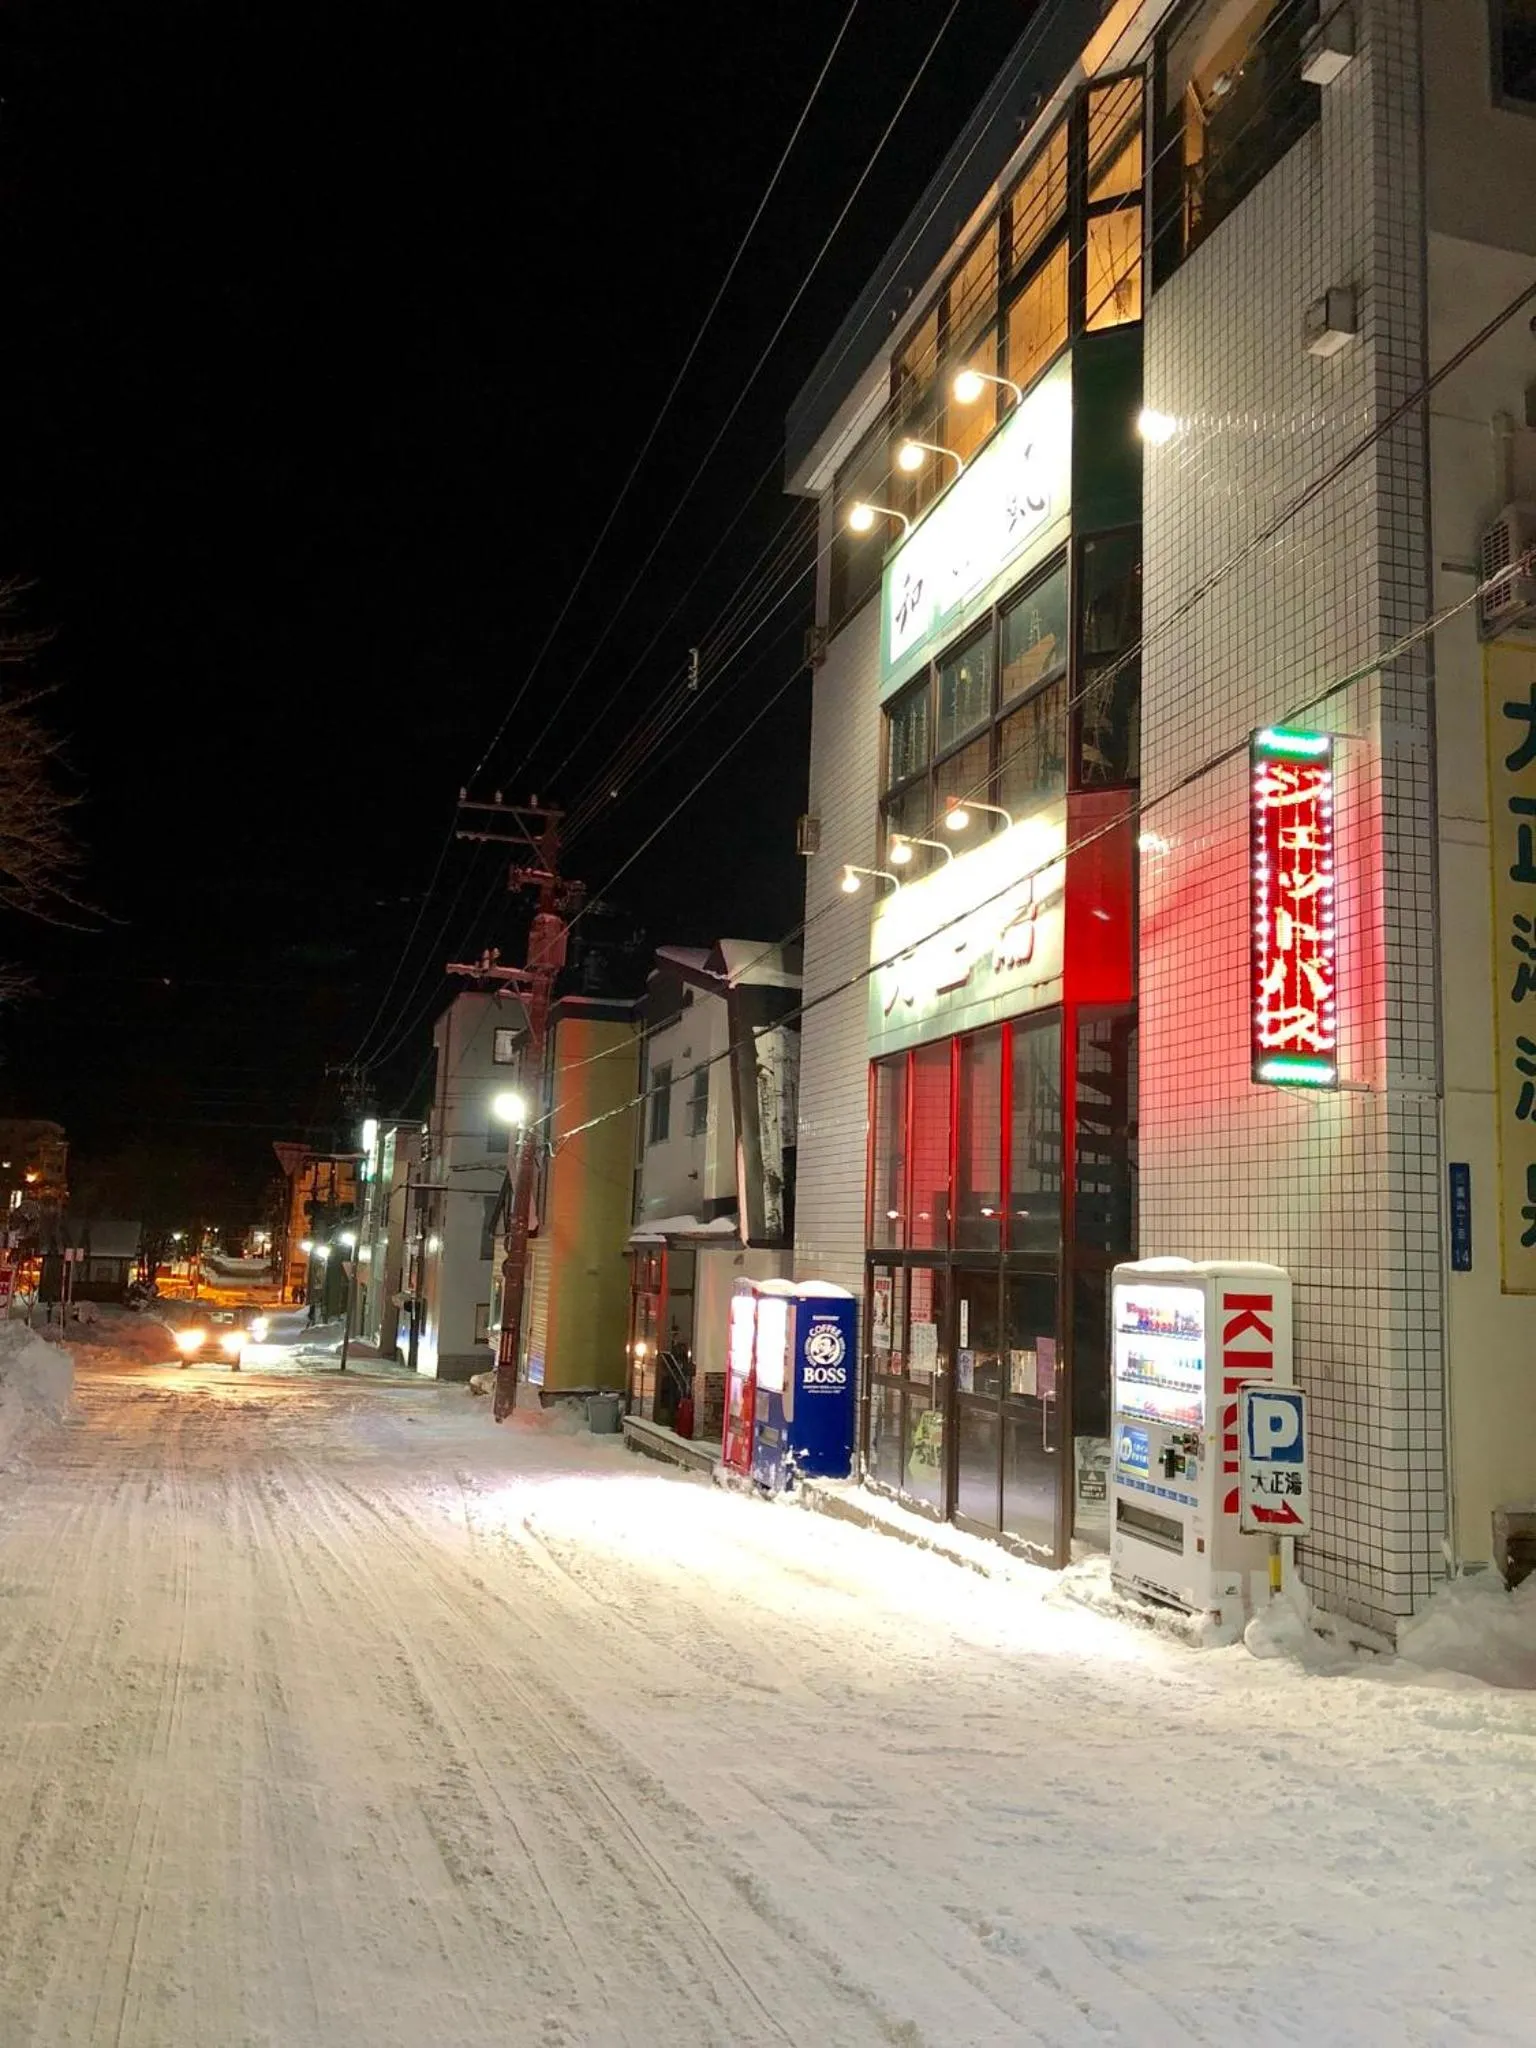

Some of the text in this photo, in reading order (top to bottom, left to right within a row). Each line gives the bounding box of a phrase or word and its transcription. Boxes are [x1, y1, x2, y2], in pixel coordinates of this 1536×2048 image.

[1257, 765, 1334, 1051] ジェットバス
[809, 1324, 842, 1337] COFFEE
[803, 1367, 847, 1384] BOSS
[1252, 1396, 1299, 1458] P
[1251, 1469, 1303, 1496] 大正湯
